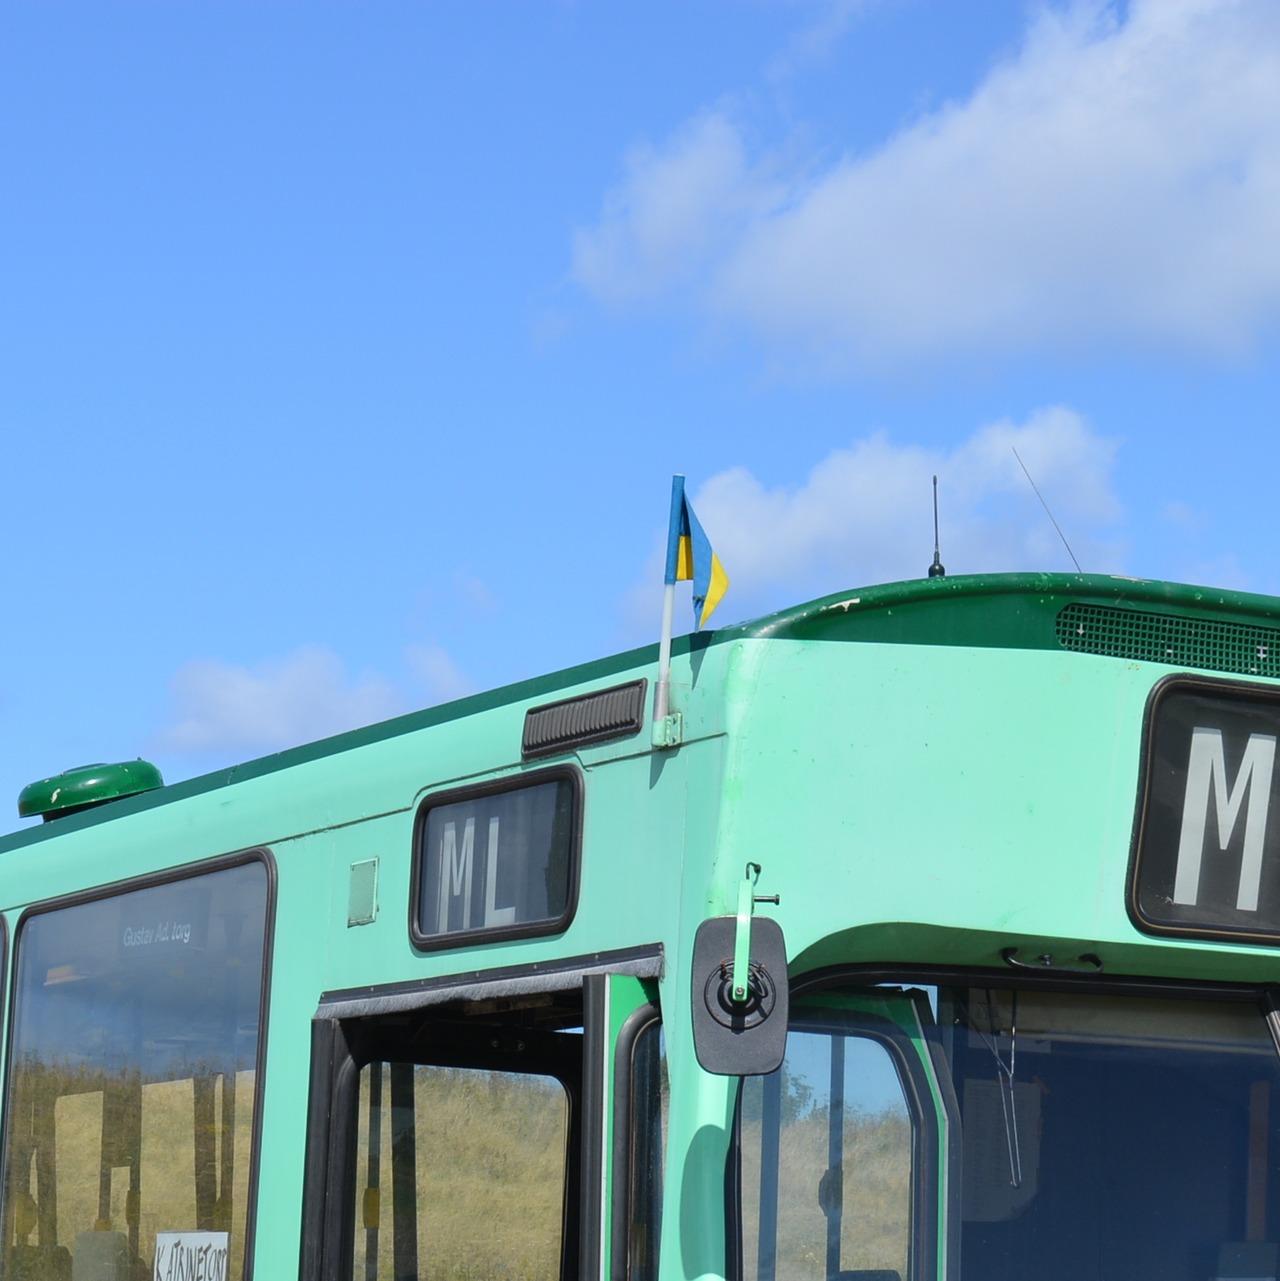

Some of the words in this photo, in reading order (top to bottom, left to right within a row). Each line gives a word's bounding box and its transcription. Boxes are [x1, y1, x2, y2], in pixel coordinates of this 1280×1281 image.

[437, 816, 516, 934] ML
[123, 926, 154, 946] Gustav
[171, 920, 191, 944] torg
